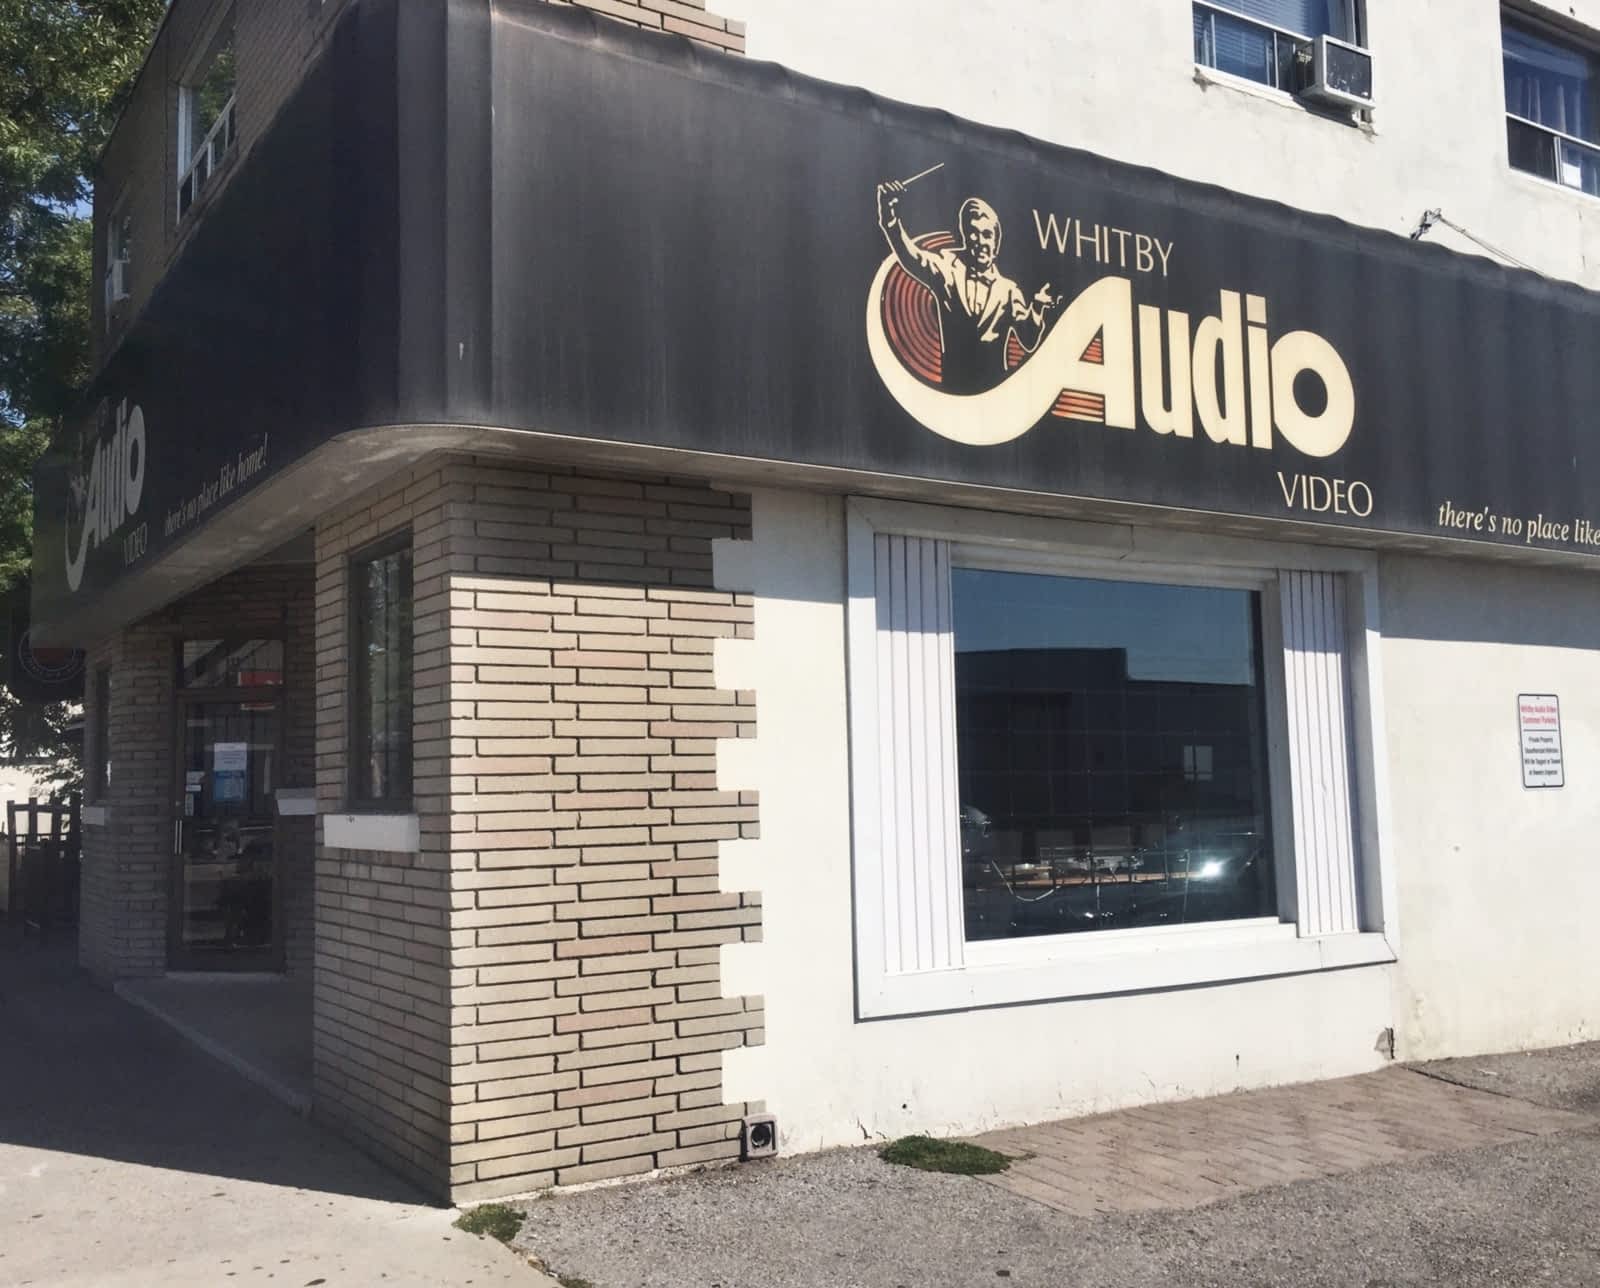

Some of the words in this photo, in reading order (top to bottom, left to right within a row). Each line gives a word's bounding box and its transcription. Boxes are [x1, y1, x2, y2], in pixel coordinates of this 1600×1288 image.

[1033, 208, 1174, 278] WHITBY
[866, 272, 1356, 458] Audio
[65, 397, 146, 592] Audio
[1277, 471, 1373, 518] VIDEO
[1438, 500, 1497, 533] there's
[1502, 516, 1522, 536] no
[1526, 513, 1569, 544] place
[1574, 518, 1600, 546] like
